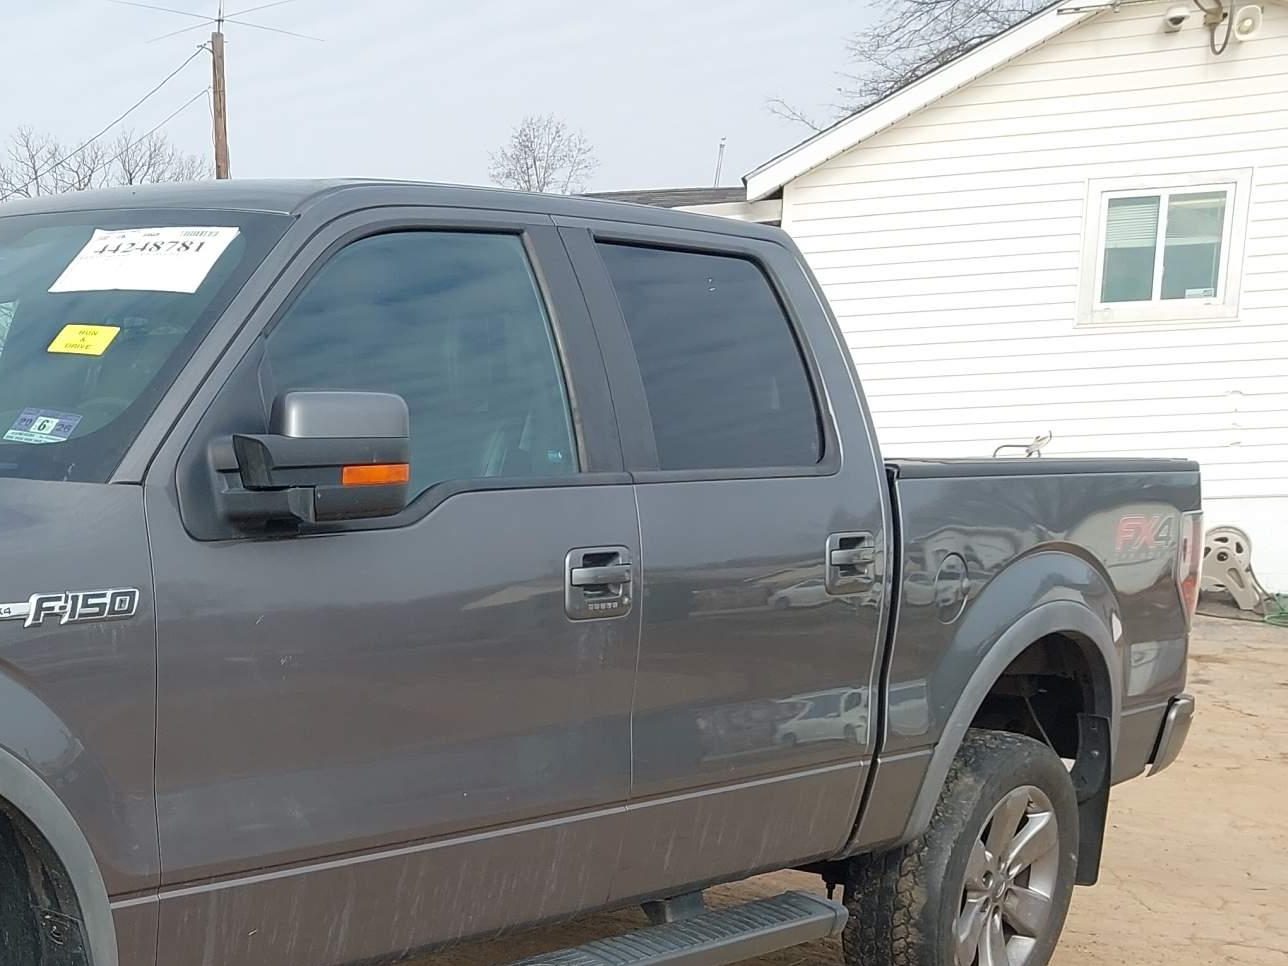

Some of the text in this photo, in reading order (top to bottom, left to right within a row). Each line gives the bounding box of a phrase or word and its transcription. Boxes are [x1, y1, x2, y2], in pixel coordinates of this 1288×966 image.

[94, 240, 206, 255] 44248781
[78, 329, 99, 337] RUN
[37, 419, 50, 432] 6
[1114, 513, 1177, 552] FX4
